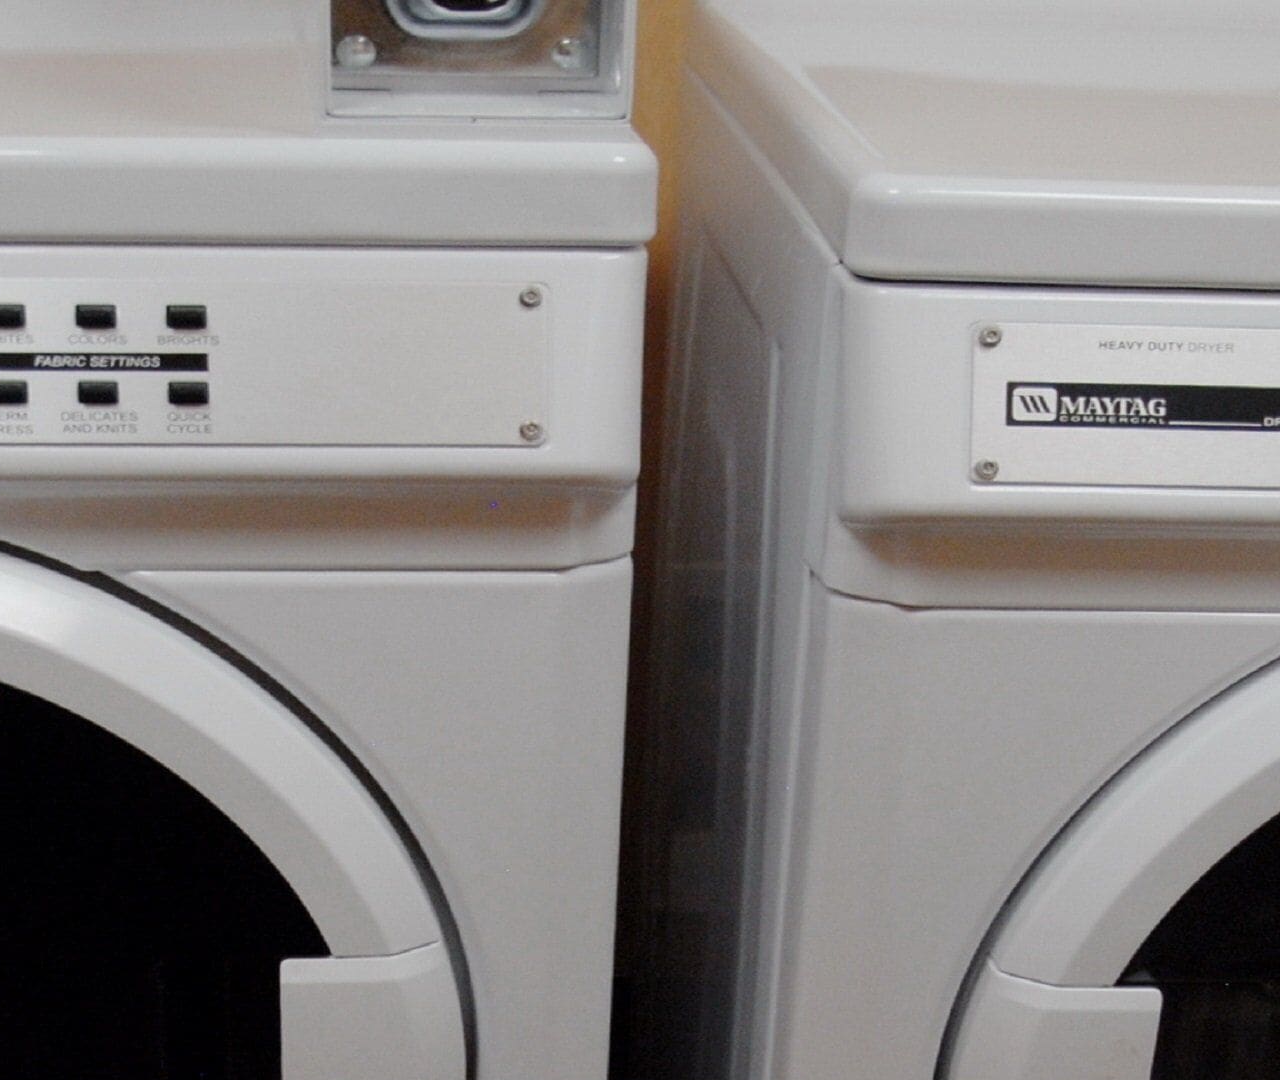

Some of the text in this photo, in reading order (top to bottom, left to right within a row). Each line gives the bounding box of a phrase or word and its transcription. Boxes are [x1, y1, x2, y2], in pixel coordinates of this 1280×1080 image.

[68, 335, 128, 346] COLORS
[157, 335, 220, 347] BRIGHTS
[1098, 340, 1235, 353] HEAVY DUTY DRYER
[34, 355, 161, 368] FABRIC SETTINGS
[1059, 395, 1167, 417] MAYTAG
[61, 411, 139, 422] DELICATES
[166, 411, 211, 422] QUICK
[1059, 414, 1166, 425] COMMERCIAL
[166, 424, 212, 434] CYCLE
